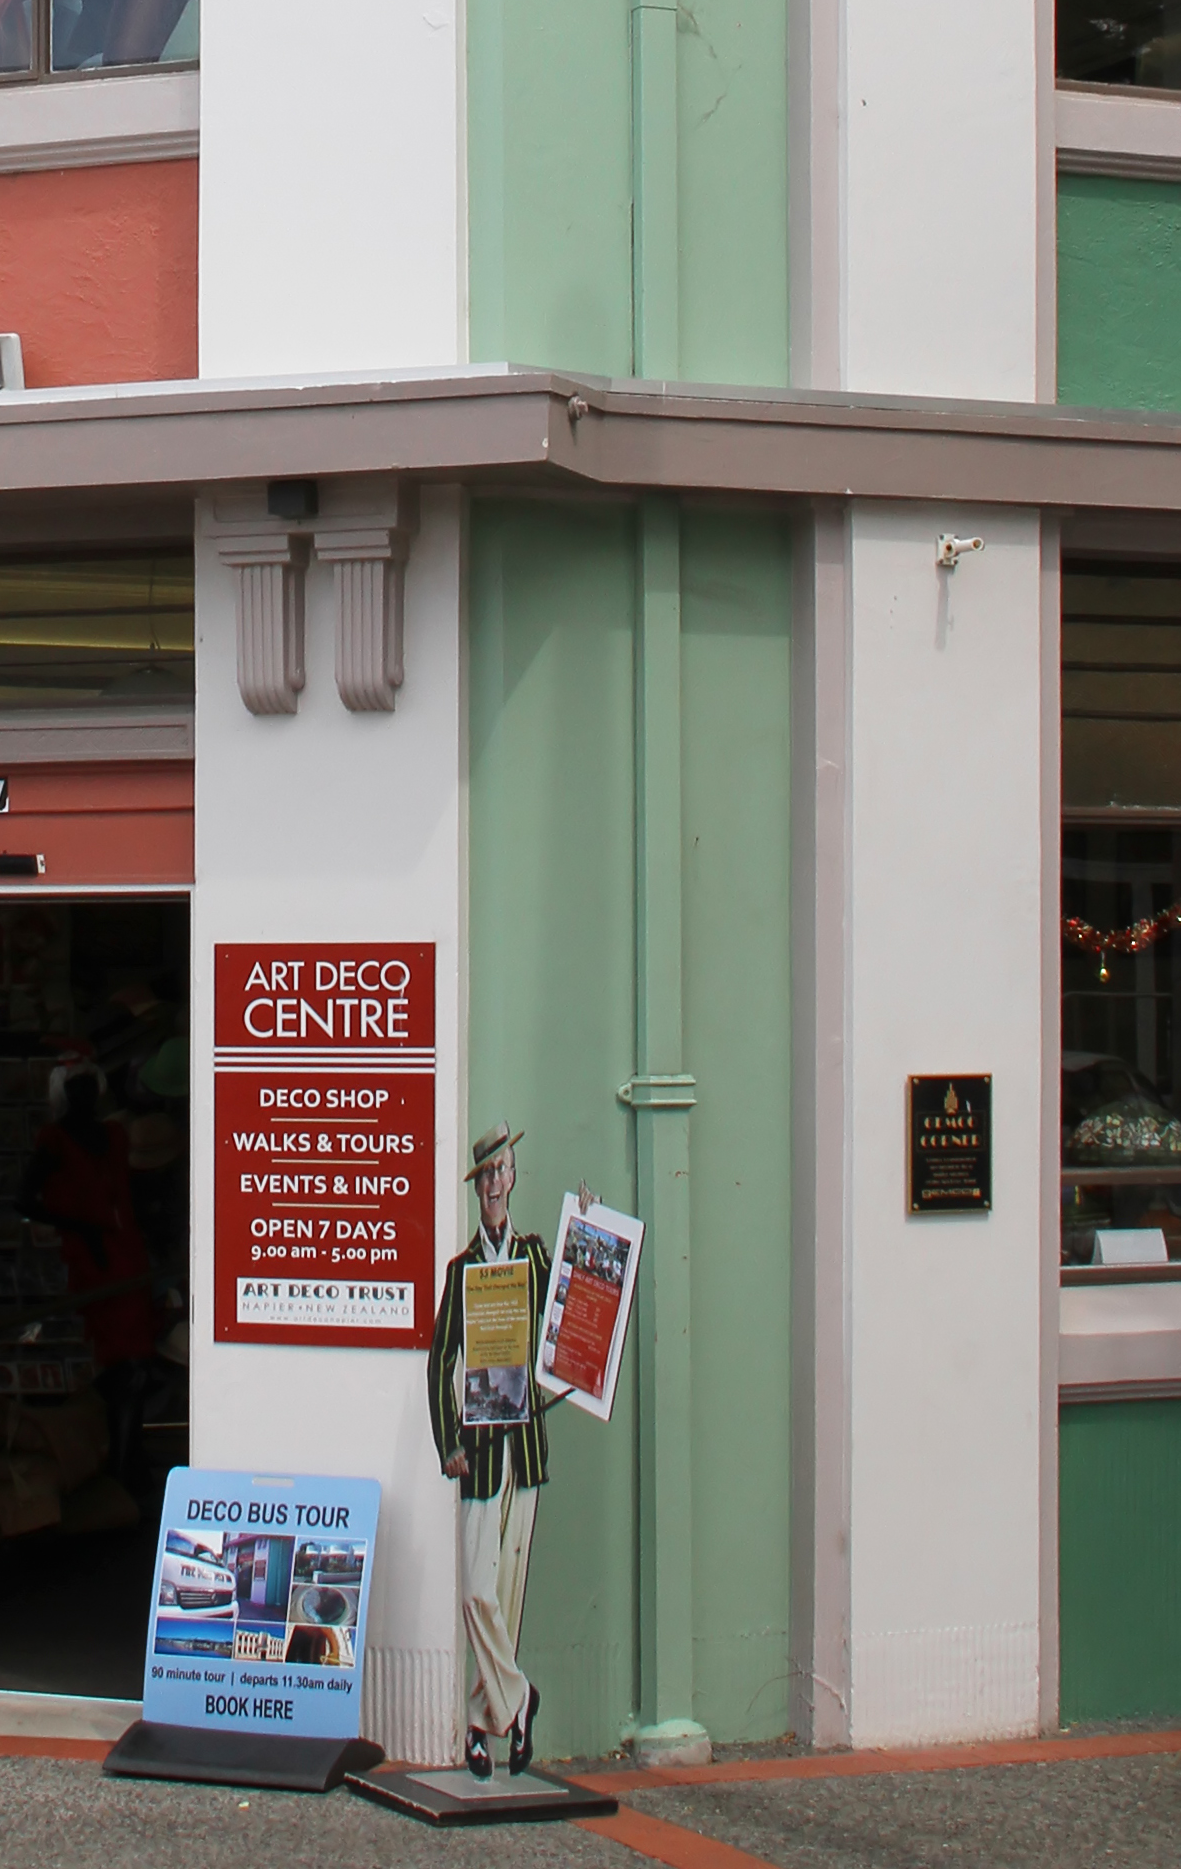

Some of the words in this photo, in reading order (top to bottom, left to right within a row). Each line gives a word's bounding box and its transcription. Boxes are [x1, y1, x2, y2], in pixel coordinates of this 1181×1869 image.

[244, 961, 305, 991] ART
[315, 960, 411, 991] DECO
[243, 997, 409, 1038] CENTRE
[259, 1088, 321, 1108] DECO
[325, 1089, 389, 1108] SHOP
[232, 1132, 312, 1152] WALKS
[316, 1133, 334, 1152] &
[335, 1133, 415, 1153] TOURS
[920, 1134, 981, 1147] CORNER
[240, 1174, 327, 1194] EVENTS
[332, 1175, 349, 1195] &
[355, 1176, 410, 1196] INFO
[250, 1218, 315, 1239] OPEN
[318, 1220, 331, 1239] 7
[335, 1220, 397, 1240] DAYS
[250, 1244, 287, 1260] 9.00
[291, 1246, 317, 1259] am
[331, 1247, 367, 1263] 5.00
[370, 1248, 398, 1265] pm
[242, 1282, 281, 1297] ART
[288, 1284, 340, 1299] DECO
[346, 1285, 408, 1301] TRUST
[342, 1305, 410, 1315] ZEALAND
[187, 1499, 242, 1522] DECO
[247, 1502, 288, 1526] BUS
[295, 1505, 350, 1528] TOUR
[151, 1666, 164, 1679] 90
[166, 1668, 201, 1681] minute
[204, 1670, 225, 1683] tour
[240, 1671, 278, 1688] departs
[327, 1678, 353, 1694] daily
[205, 1695, 249, 1716] BOOK
[253, 1698, 293, 1720] HERE
